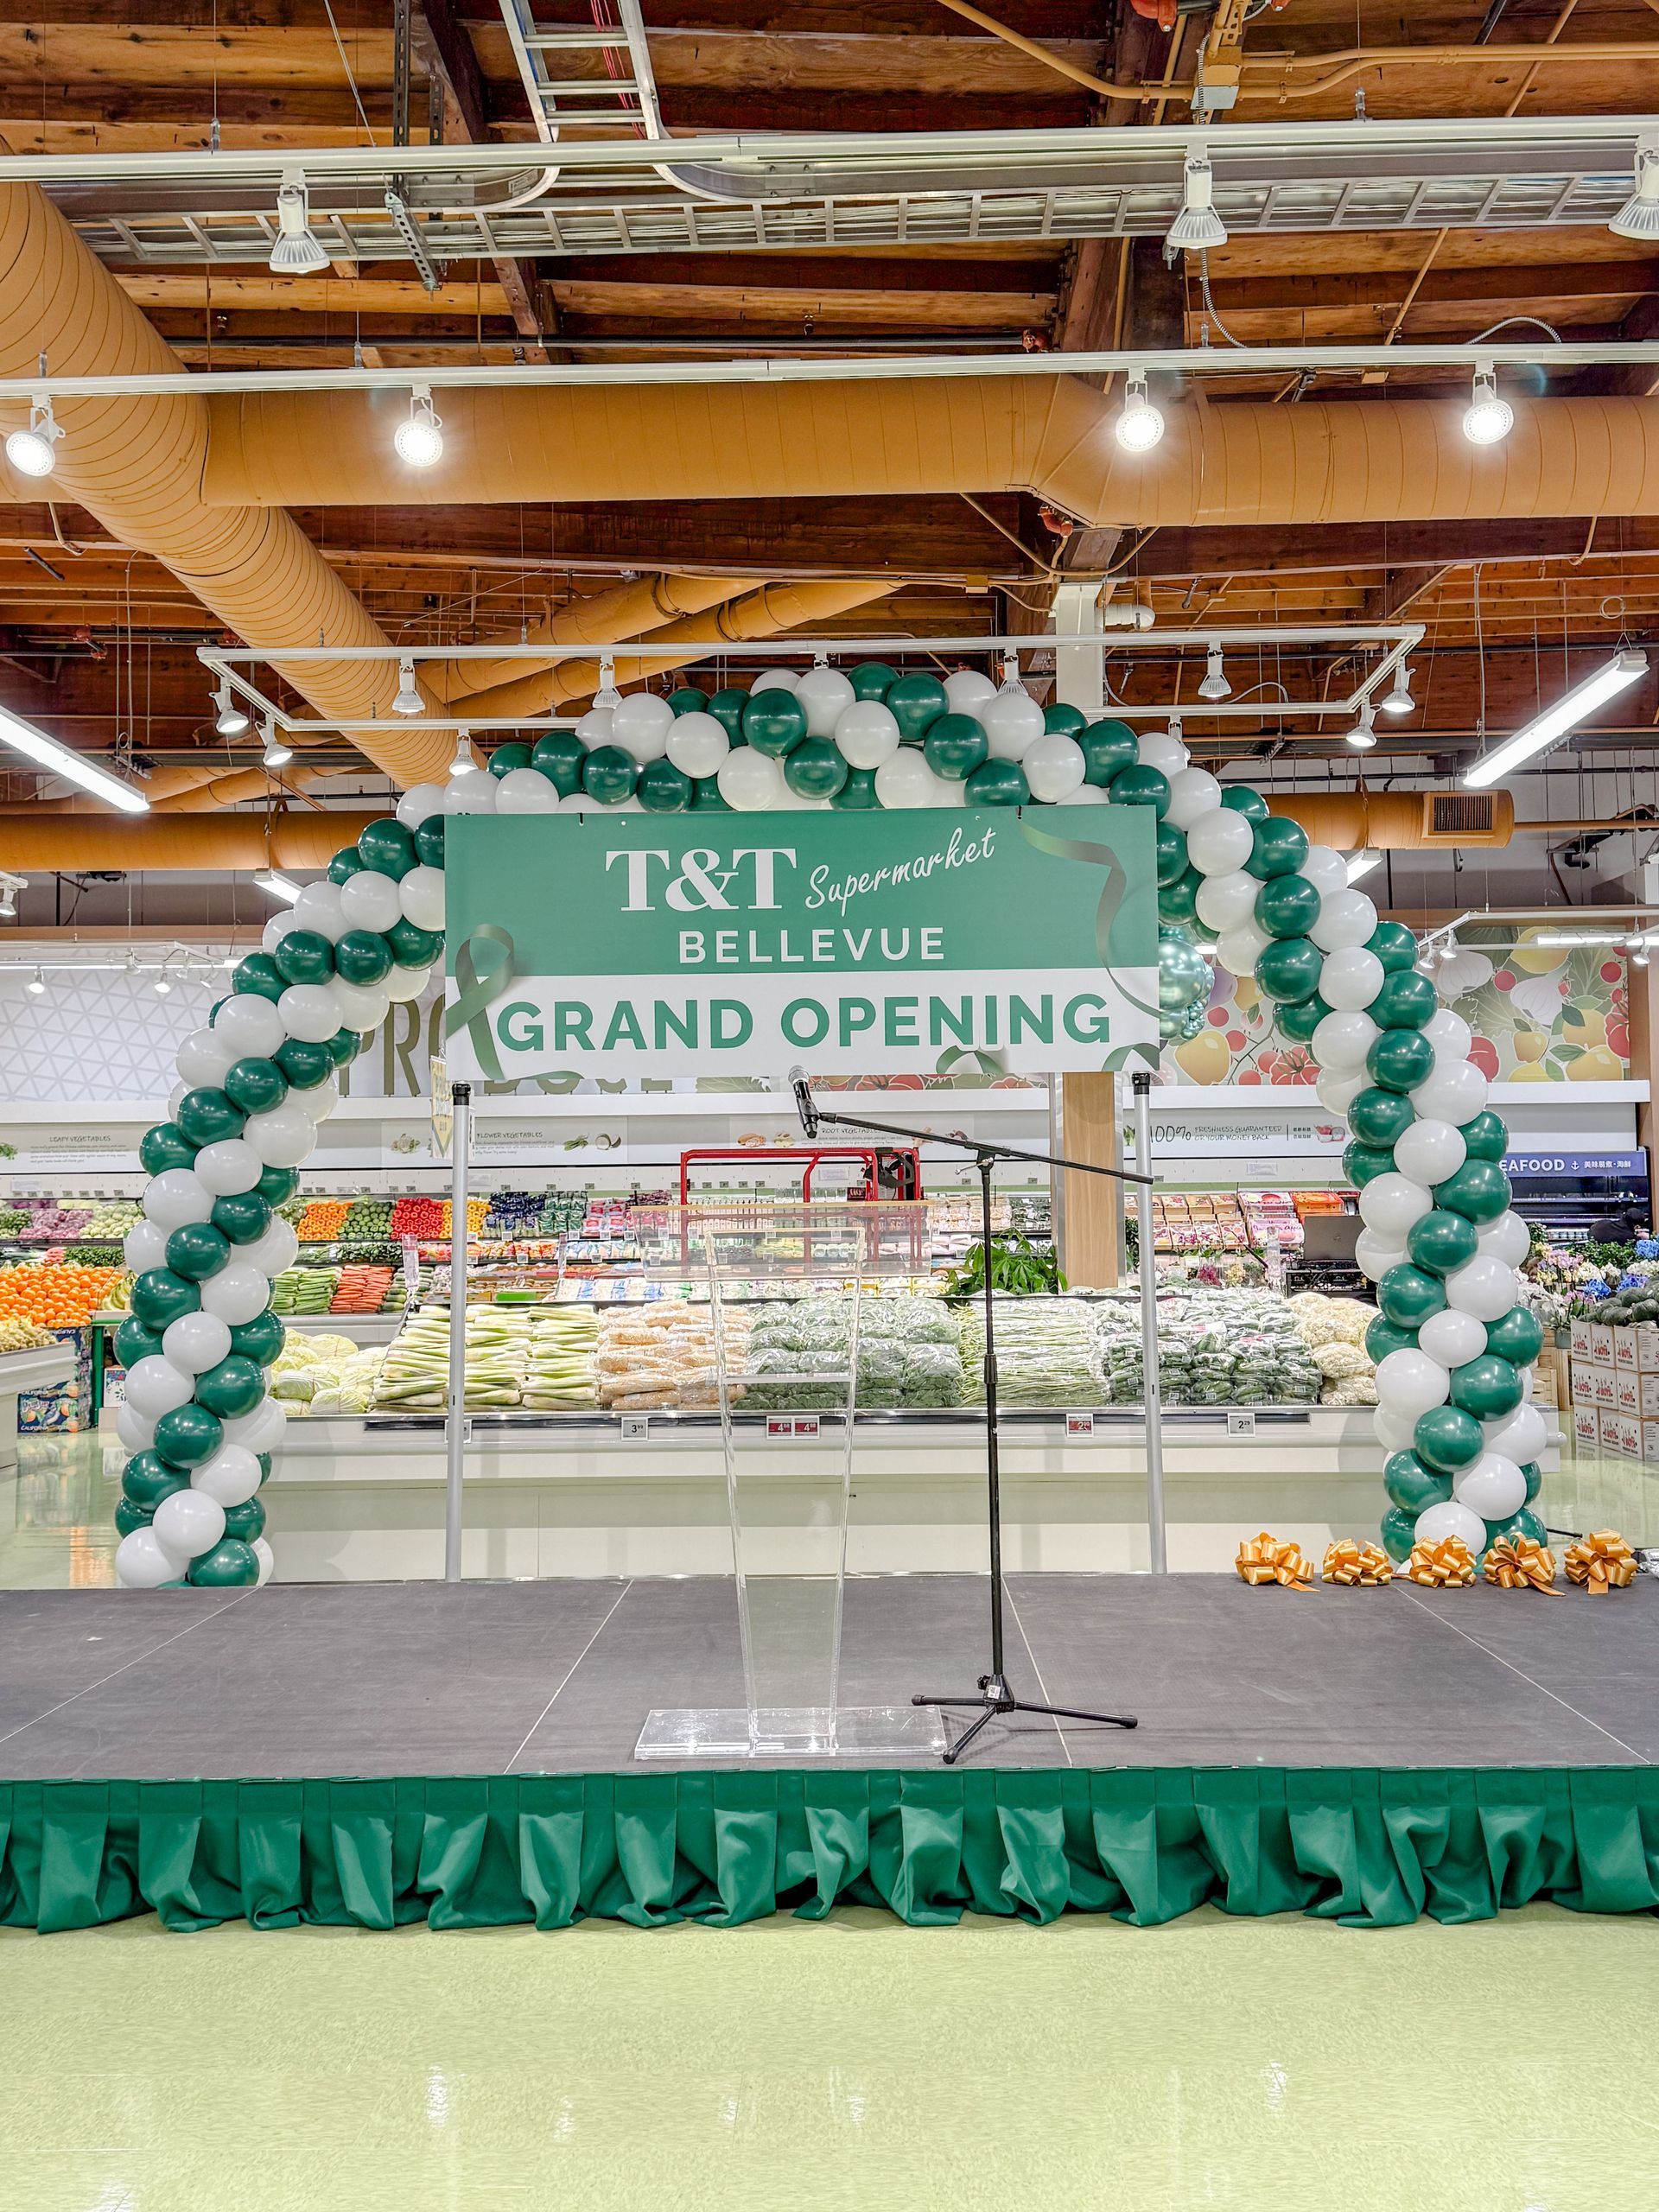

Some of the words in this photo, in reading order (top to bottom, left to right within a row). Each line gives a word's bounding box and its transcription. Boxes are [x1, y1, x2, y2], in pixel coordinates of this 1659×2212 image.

[605, 848, 797, 912] T&T
[804, 827, 996, 917] Supermarket
[679, 927, 944, 963] BELLEVUE
[497, 1000, 753, 1052] GRAND
[780, 995, 1110, 1046] OPENING
[1498, 1159, 1565, 1172] EAFOOD
